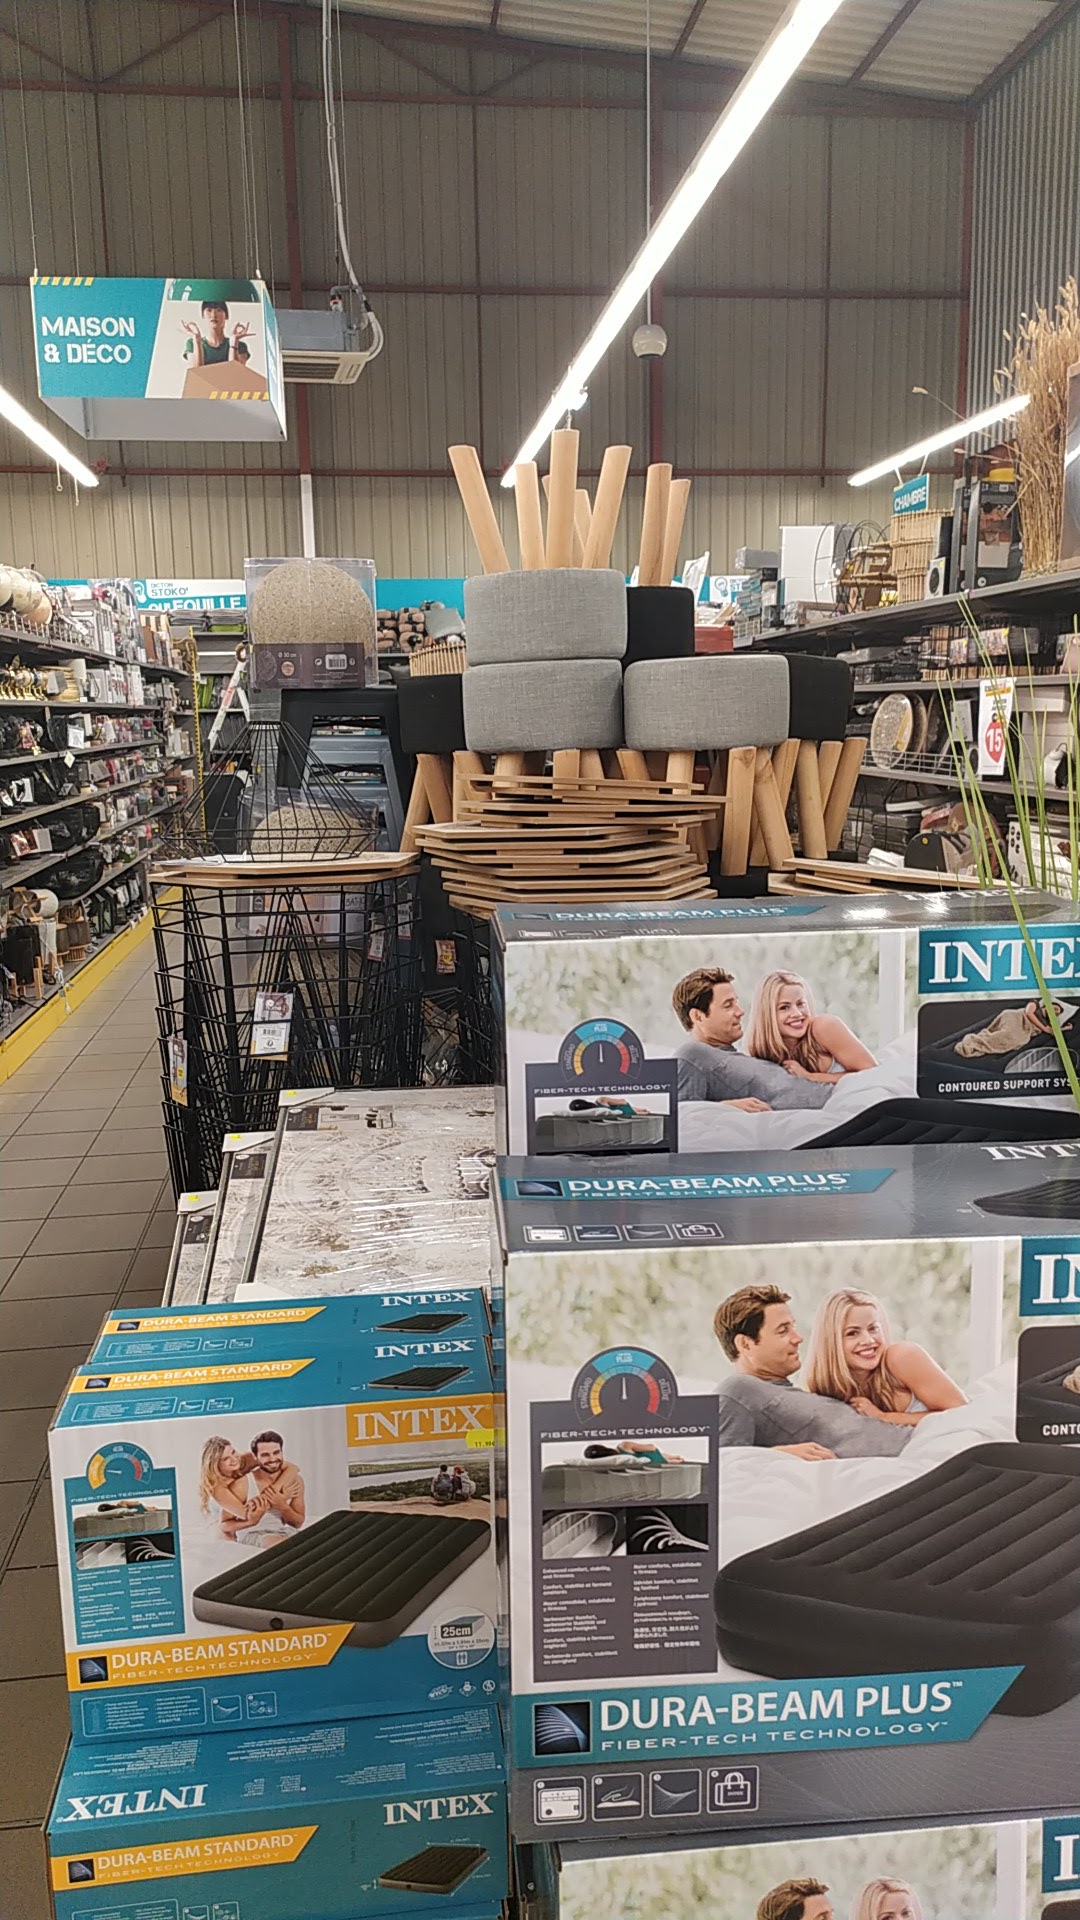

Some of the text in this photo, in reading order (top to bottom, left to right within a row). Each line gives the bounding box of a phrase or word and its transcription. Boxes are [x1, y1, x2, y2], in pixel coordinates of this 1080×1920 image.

[41, 316, 135, 337] MAISON
[44, 338, 132, 364] & DÉCO
[894, 486, 926, 511] CHAMBRE
[987, 728, 1002, 752] 15
[928, 937, 1080, 984] INTE
[534, 1086, 596, 1095] FIBER-TECH
[938, 1081, 1001, 1093] CONTOURED
[1003, 1078, 1051, 1090] SUPPORT
[567, 1176, 762, 1191] DURA-BEAM
[381, 1291, 473, 1307] INTEX
[143, 1315, 229, 1327] DURA-BEAM
[374, 1340, 474, 1358] INTEX
[113, 1369, 208, 1383] DURA-BEAM
[354, 1405, 486, 1441] INTEX
[540, 1427, 617, 1439] FIBER-TECH
[442, 1626, 471, 1637] 25cm
[111, 1643, 225, 1669] DURA-BEAM
[112, 1665, 206, 1680] FIBER-TECH
[600, 1688, 844, 1732] DURA-BEAM
[601, 1733, 757, 1751] FIBER-TECH
[97, 1845, 200, 1870] DURA-BEAM
